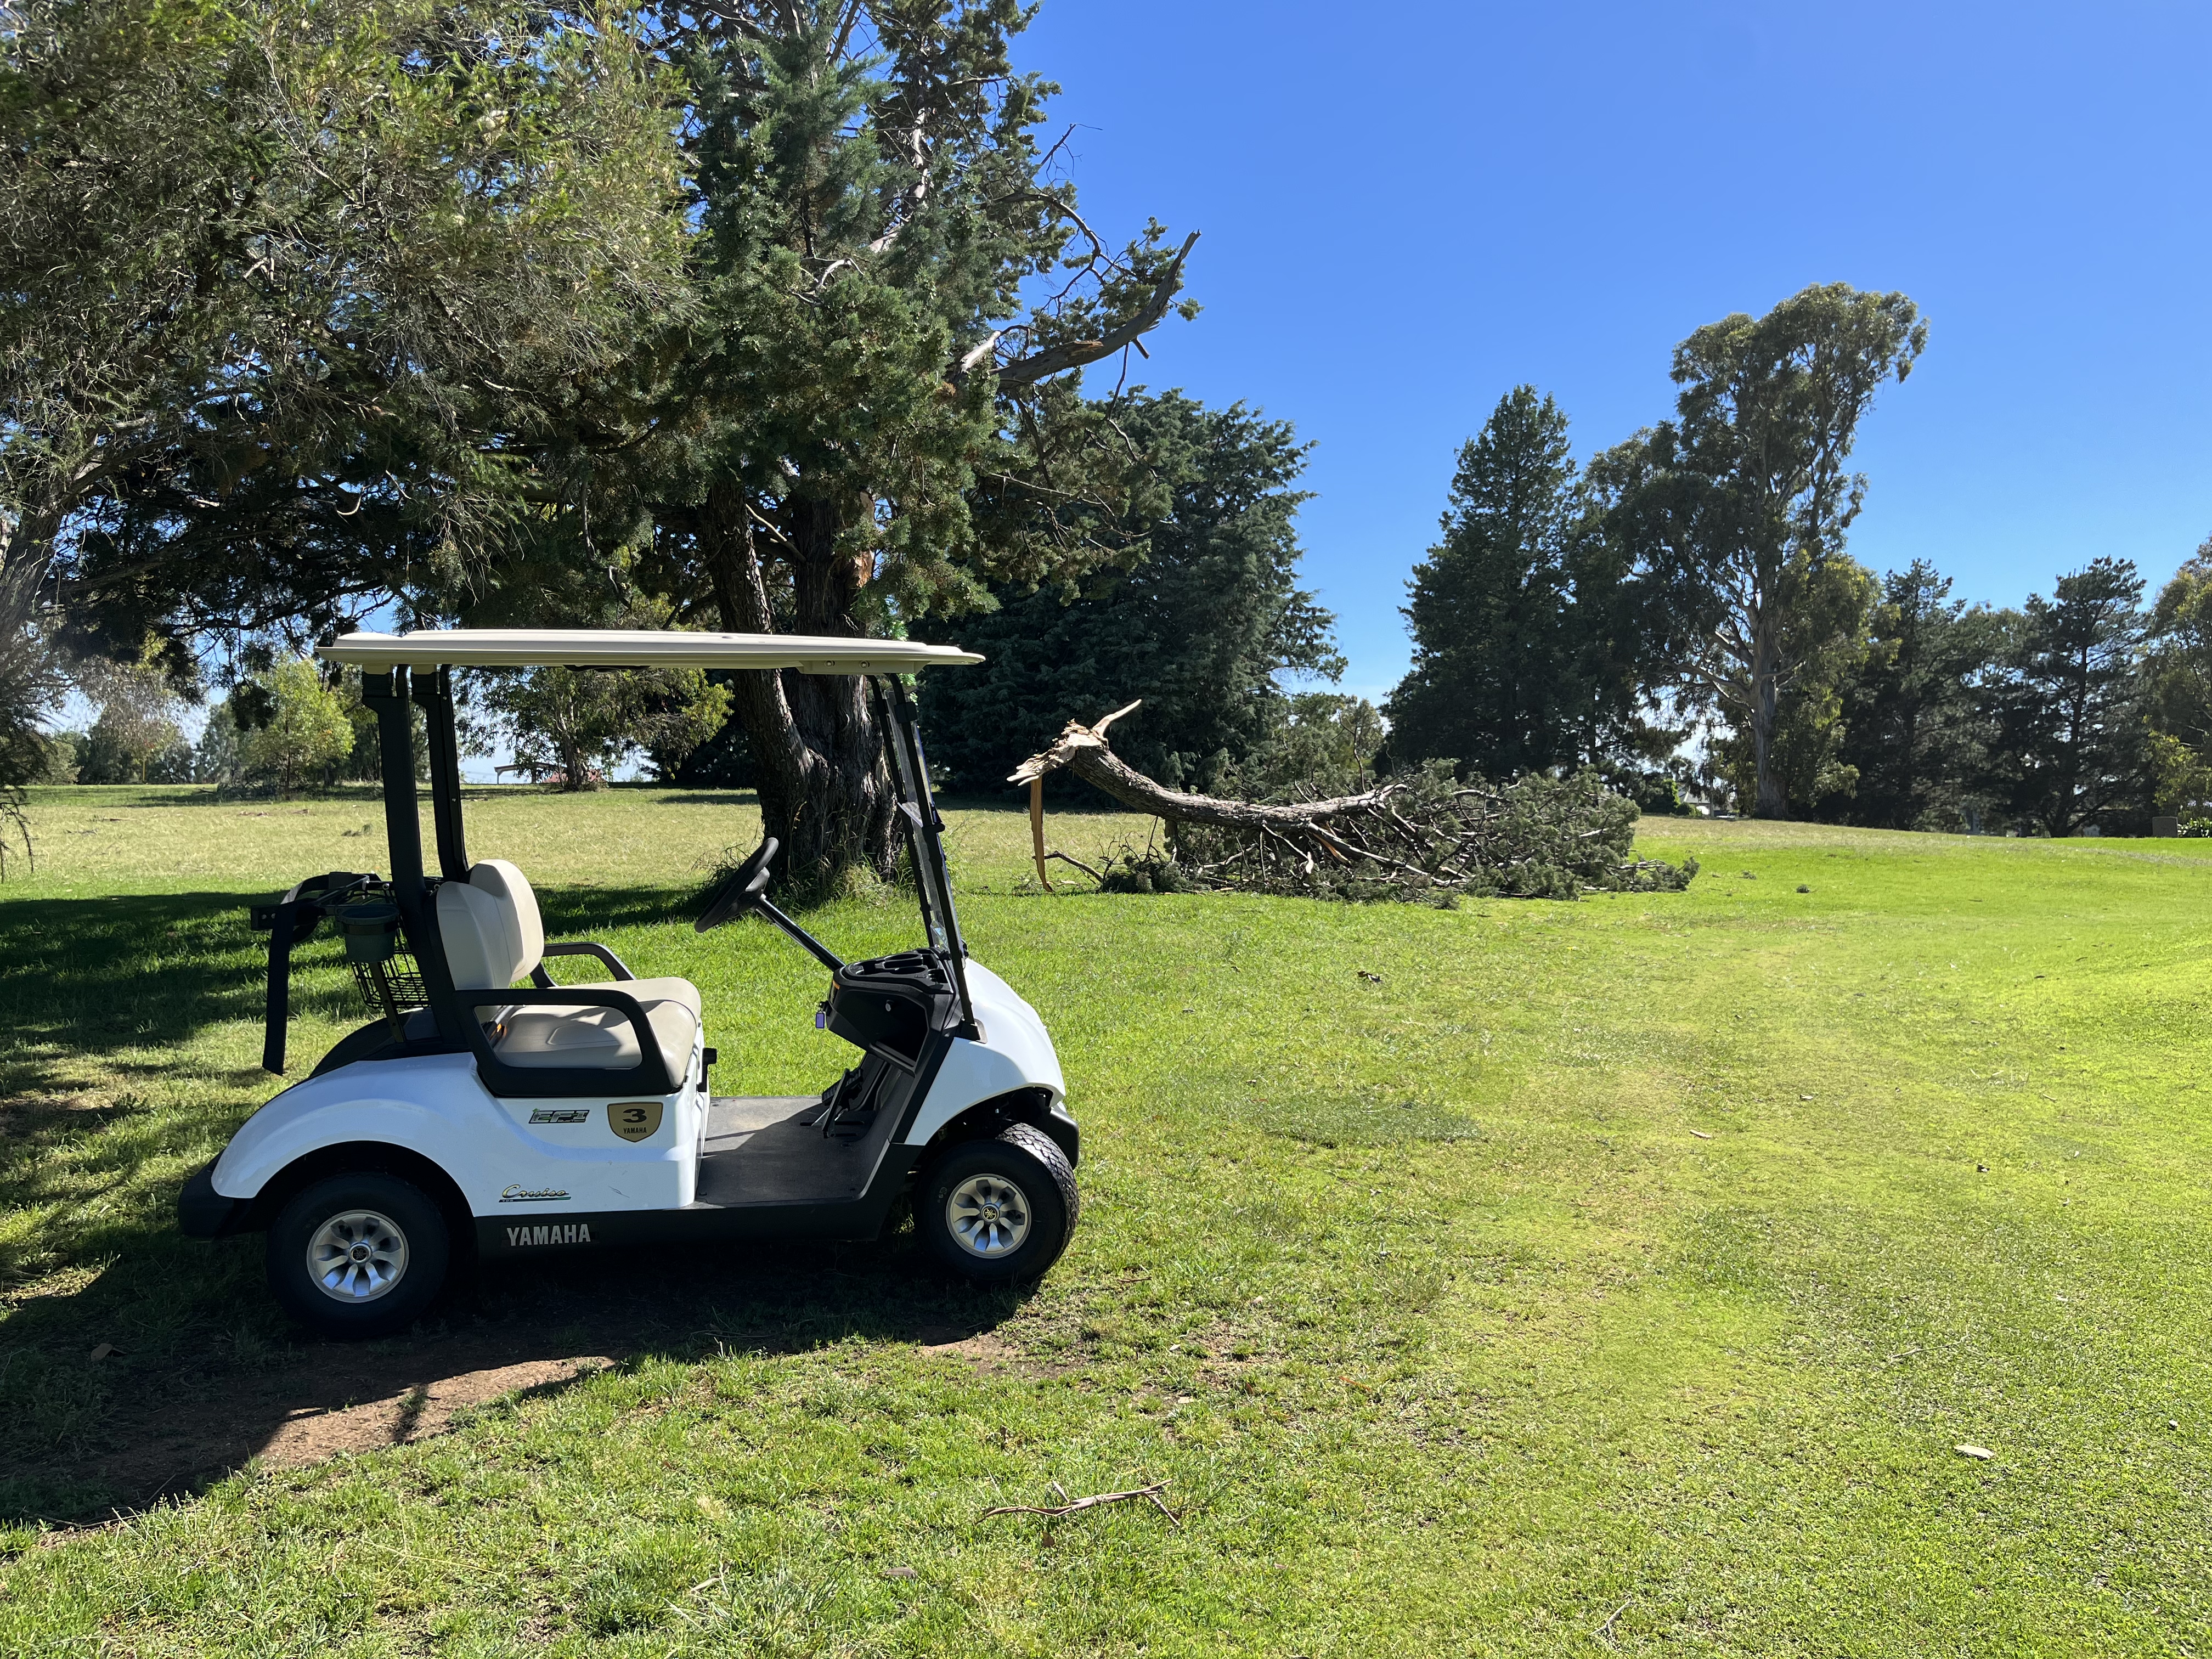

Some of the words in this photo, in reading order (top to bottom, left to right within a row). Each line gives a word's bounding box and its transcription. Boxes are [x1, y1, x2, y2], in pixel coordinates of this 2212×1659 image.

[530, 1110, 589, 1123] EFI
[622, 1108, 647, 1123] 3
[501, 1184, 569, 1198] Cruise
[506, 1223, 591, 1246] YAMAHA
